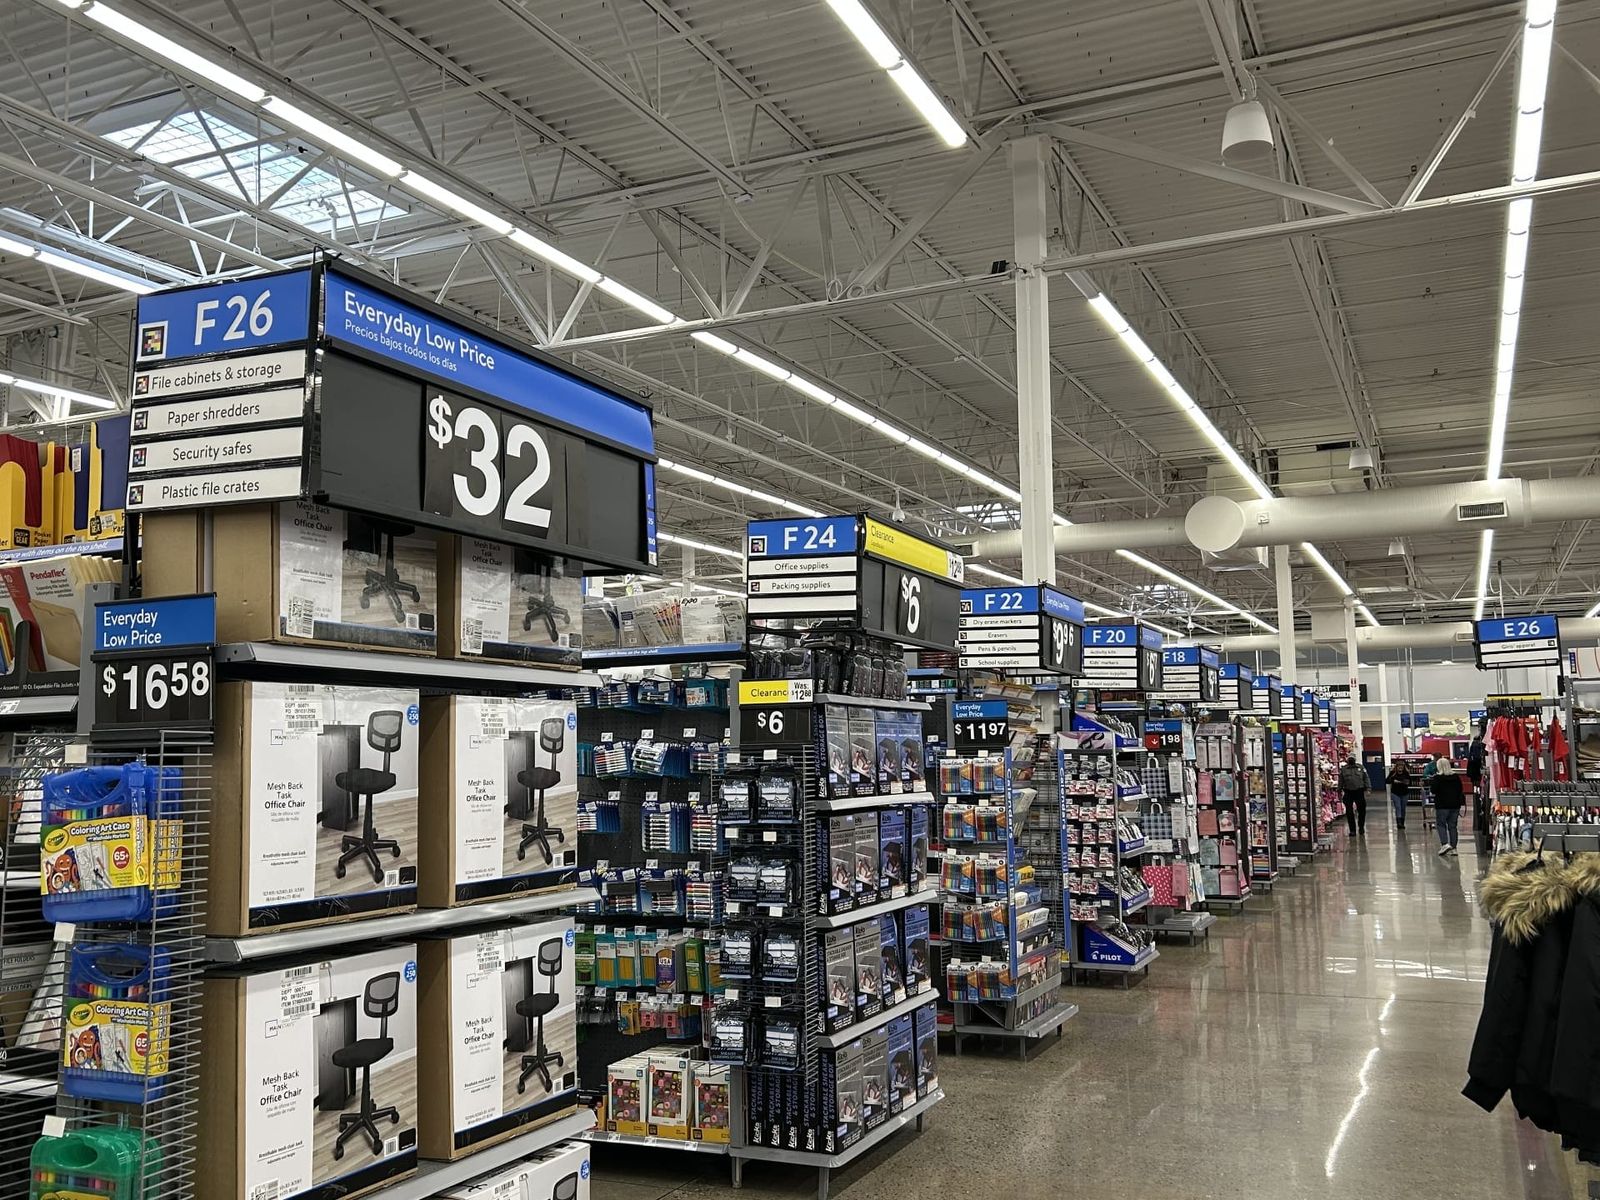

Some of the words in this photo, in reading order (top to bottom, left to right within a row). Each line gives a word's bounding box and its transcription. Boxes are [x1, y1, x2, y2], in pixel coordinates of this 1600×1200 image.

[194, 299, 219, 346] F
[223, 289, 274, 340] 26
[344, 290, 422, 345] Everyday
[425, 324, 456, 354] Low
[459, 338, 495, 370] Price
[345, 319, 379, 342] Precios
[380, 334, 403, 351] bajos
[404, 343, 427, 360] todos
[429, 350, 440, 365] los
[151, 377, 172, 390] File
[174, 370, 222, 387] cabinets
[224, 366, 233, 381] &
[237, 363, 282, 379] storage
[168, 411, 200, 427] Paper
[202, 404, 260, 420] shredders
[172, 444, 220, 461] Security
[222, 441, 252, 455] safes
[428, 393, 553, 529] $32
[162, 484, 199, 499] Plastic
[202, 482, 220, 495] file
[223, 480, 260, 494] crates
[296, 501, 314, 512] Mesh
[316, 504, 330, 514] Back
[306, 512, 320, 521] Task
[294, 518, 314, 529] Office
[316, 521, 333, 532] Chair
[784, 526, 799, 550] F
[804, 524, 837, 549] 24
[472, 556, 488, 565] Office
[489, 558, 503, 566] Chair
[774, 562, 798, 571] Office
[799, 561, 829, 573] supplies
[30, 568, 66, 580] Pendaflex
[771, 582, 800, 592] Packing
[801, 581, 831, 592] supplies
[984, 593, 996, 611] F
[1000, 592, 1023, 610] 22
[103, 609, 158, 629] Everyday
[1504, 623, 1515, 637] E
[1518, 621, 1540, 636] 26
[103, 632, 127, 647] Low
[131, 630, 162, 645] Price
[1092, 630, 1102, 643] F
[1106, 630, 1126, 643] 20
[997, 659, 1020, 667] supplies
[1162, 652, 1169, 662] F
[1172, 651, 1186, 662] 18
[956, 704, 981, 712] Everyday
[757, 711, 784, 735] $6
[267, 782, 286, 790] Mesh
[287, 782, 304, 790] Back
[264, 801, 286, 809] Office
[288, 800, 306, 808] Chair
[70, 825, 100, 836] Coloring
[100, 823, 112, 832] Art
[112, 822, 131, 831] Case
[96, 1005, 125, 1016] Coloring
[125, 1007, 136, 1016] Art
[465, 1020, 480, 1028] Mesh
[481, 1016, 493, 1024] Back
[464, 1035, 481, 1045] Office
[481, 1032, 495, 1041] Chair
[262, 1074, 281, 1086] Mesh
[283, 1069, 299, 1080] Back
[272, 1083, 288, 1092] Task
[260, 1094, 282, 1106] Office
[284, 1088, 302, 1100] Chair
